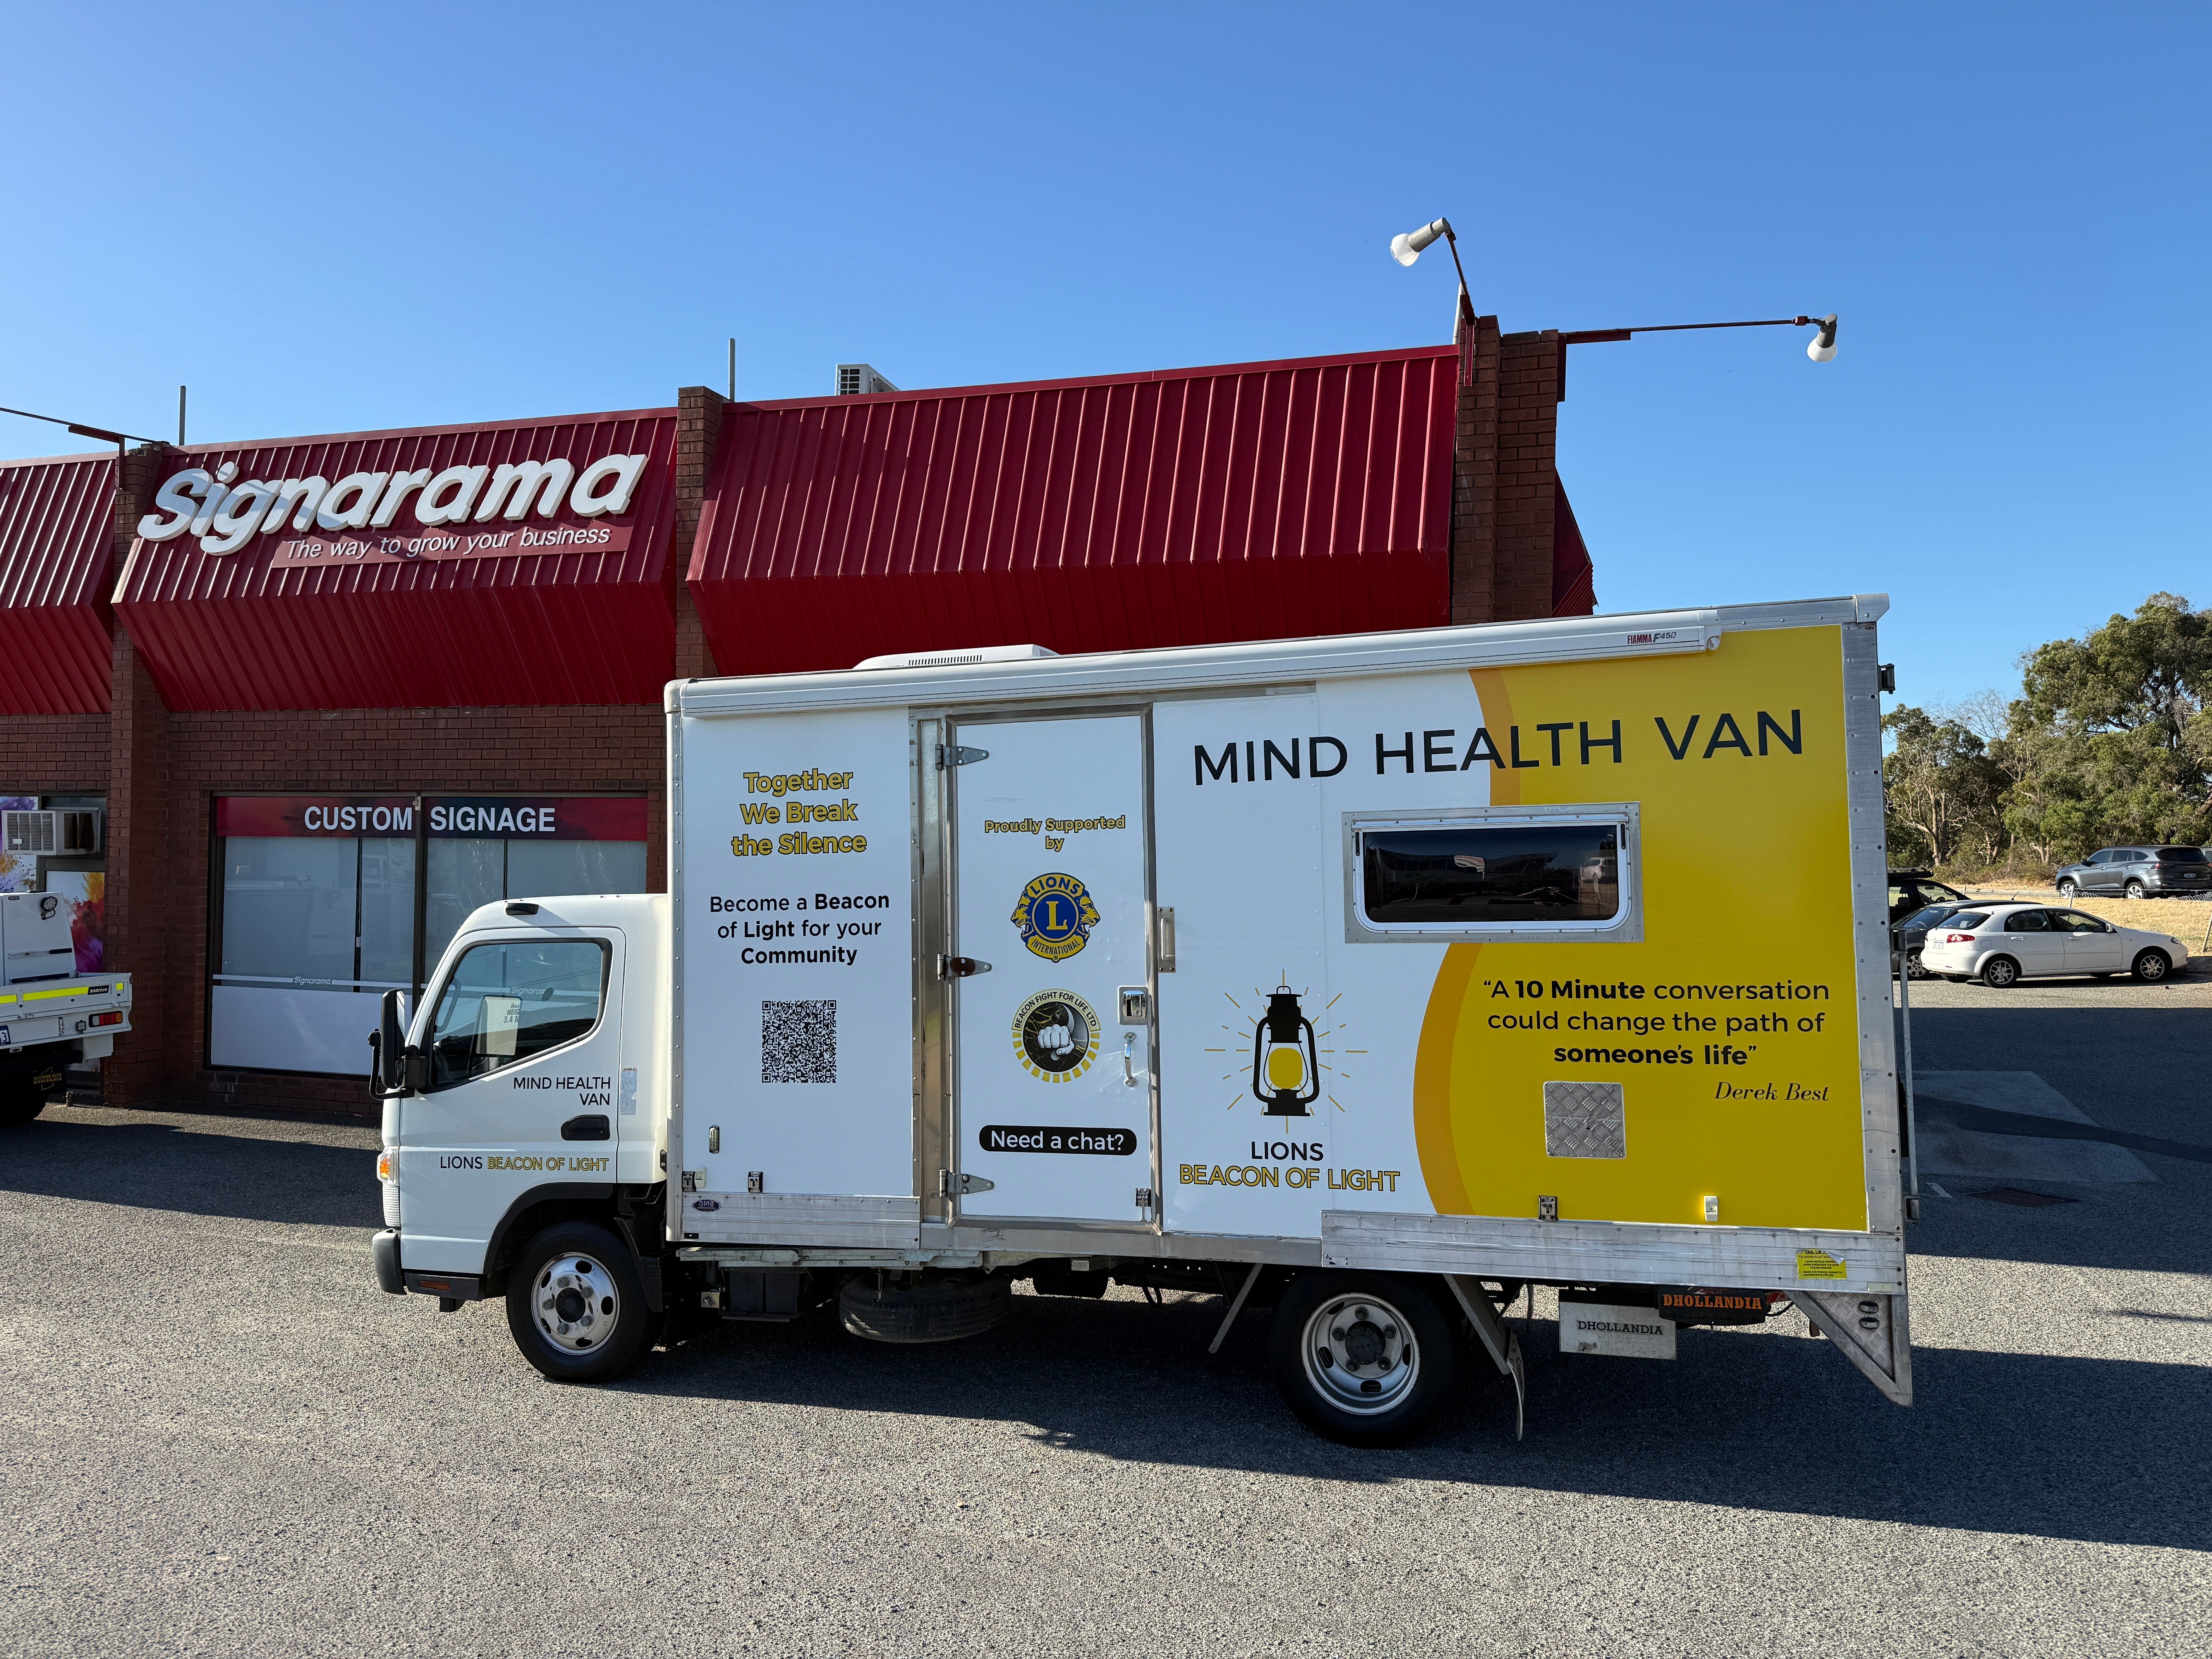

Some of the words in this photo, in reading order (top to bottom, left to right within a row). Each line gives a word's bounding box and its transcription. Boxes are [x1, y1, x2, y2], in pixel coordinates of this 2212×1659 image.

[137, 454, 647, 556] Signarama
[287, 541, 321, 559] The
[330, 540, 372, 560] way
[381, 538, 400, 554] to
[406, 536, 462, 557] grow
[464, 532, 515, 555] your
[520, 528, 610, 547] business
[1628, 634, 1652, 644] FIAMMA
[1195, 736, 1348, 786] MIND
[1376, 720, 1622, 775] HEALTH
[1654, 709, 1802, 760] VAN
[743, 768, 854, 797] Together
[304, 806, 412, 831] CUSTOM
[430, 806, 556, 832] SIGNAGE
[740, 803, 780, 825] We
[787, 799, 859, 823] Break
[985, 818, 1042, 835] Proudly
[1045, 815, 1125, 833] Supported
[732, 835, 773, 856] the
[778, 831, 867, 856] Silence
[1045, 836, 1064, 852] by
[1030, 876, 1080, 895] LIONS
[711, 896, 789, 913] Become
[797, 898, 807, 910] a
[815, 893, 889, 909] Beacon
[1046, 901, 1068, 930] L
[718, 922, 738, 938] of
[744, 920, 795, 941] Light
[802, 920, 830, 936] for
[837, 921, 882, 939] your
[741, 946, 857, 966] Community
[1031, 939, 1080, 955] INTERNATIONAL
[294, 976, 331, 985] Signarama
[511, 986, 545, 995] Signara
[1515, 980, 1544, 999] 10
[1551, 978, 1645, 1000] Minute
[1654, 979, 1830, 1001] conversation
[1014, 999, 1036, 1029] BEACON
[1035, 992, 1058, 1003] FIGHT
[1059, 992, 1074, 1002] FOR
[1074, 998, 1089, 1012] LIFE
[1086, 1012, 1097, 1027] LTD
[1487, 1010, 1558, 1030] could
[1567, 1010, 1666, 1036] change
[1672, 1012, 1717, 1032] the
[1726, 1011, 1788, 1036] path
[1797, 1012, 1827, 1033] of
[514, 1077, 552, 1089] MIND
[556, 1077, 611, 1089] HEALTH
[1713, 1082, 1778, 1101] Derek
[1784, 1083, 1830, 1102] Best
[579, 1093, 610, 1106] VAN
[991, 1130, 1043, 1149] Need
[1050, 1135, 1062, 1149] a
[1068, 1132, 1124, 1151] chat?
[1251, 1141, 1324, 1161] LIONS
[440, 1156, 483, 1170] LIONS
[487, 1157, 543, 1171] BEACON
[545, 1157, 565, 1171] OF
[568, 1158, 609, 1171] LIGHT
[1180, 1164, 1278, 1188] BEACON
[1285, 1168, 1320, 1188] OF
[1328, 1168, 1400, 1192] LIGHT
[1663, 1294, 1762, 1309] DHOLLANDIA
[1577, 1320, 1664, 1335] DHOLLANDIA
